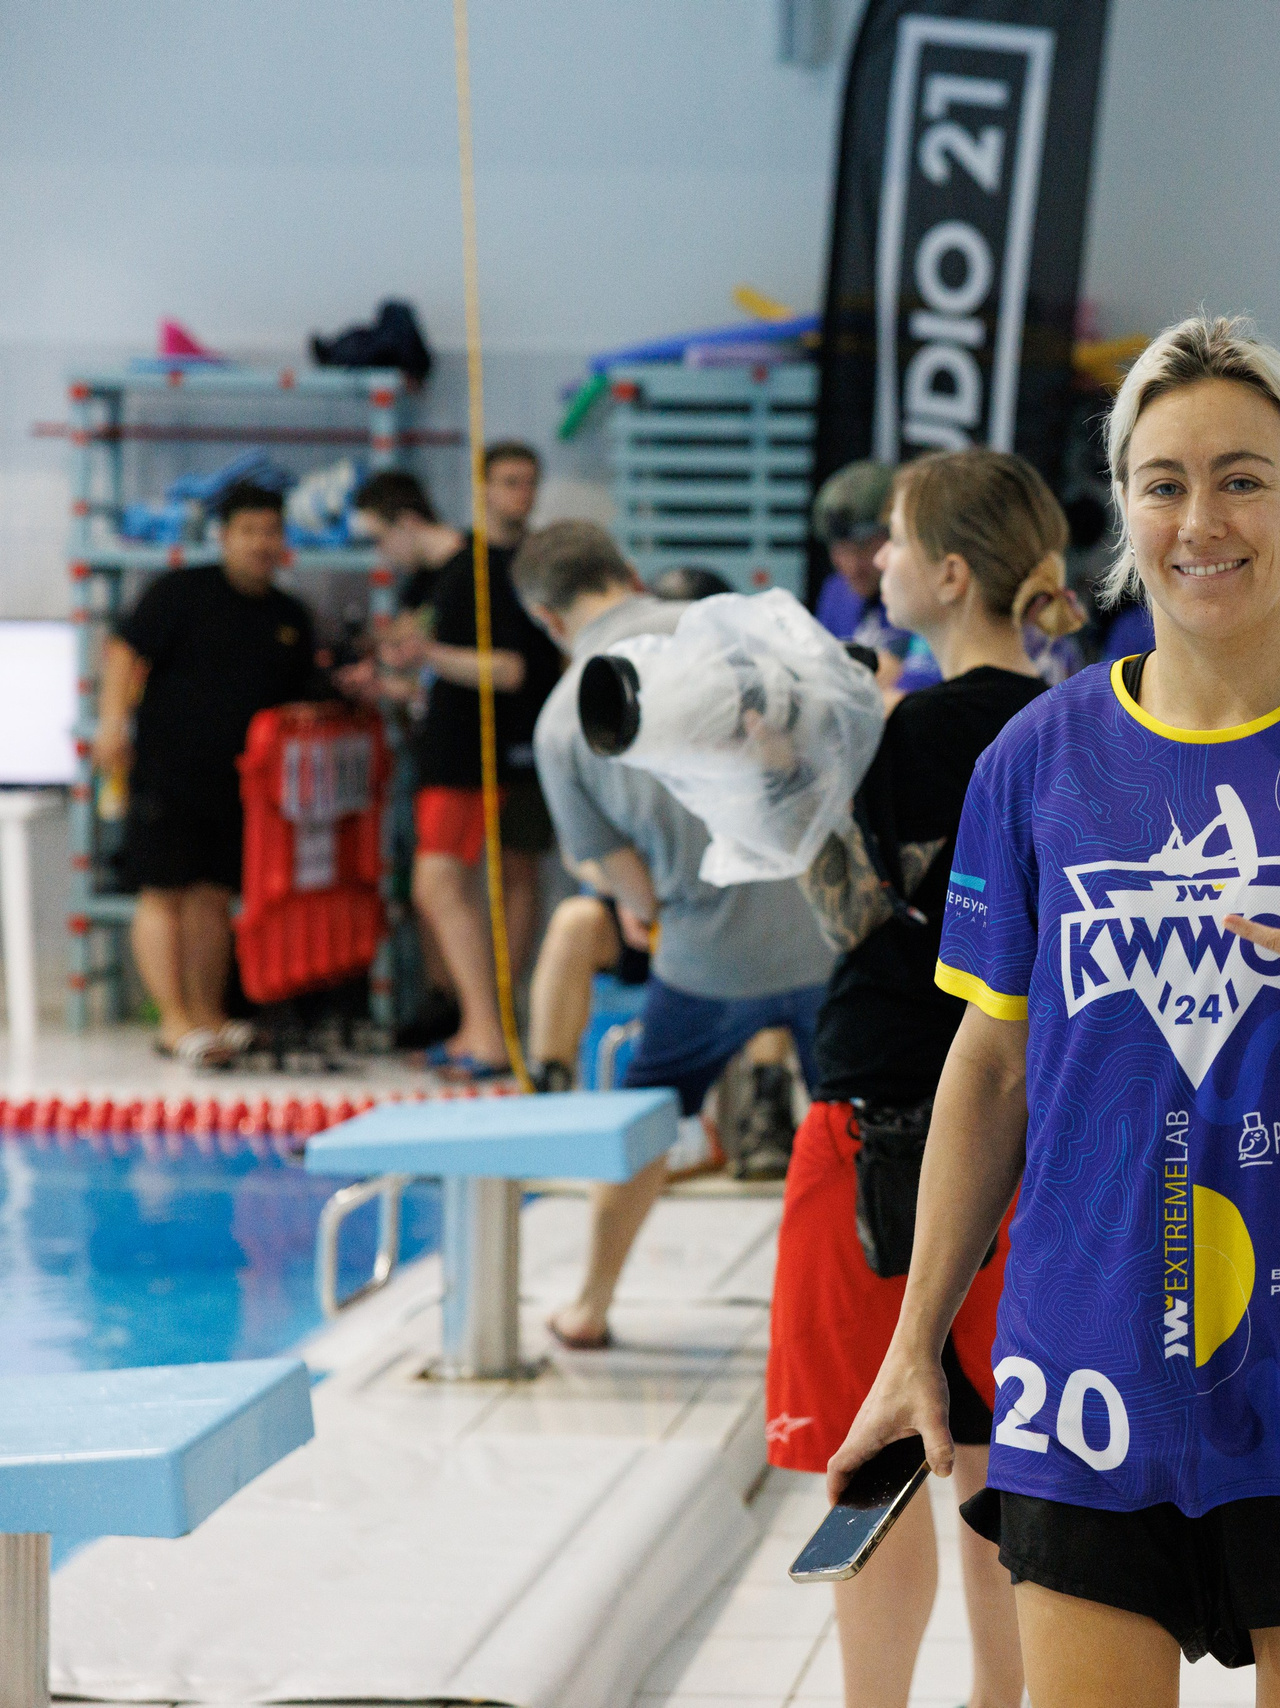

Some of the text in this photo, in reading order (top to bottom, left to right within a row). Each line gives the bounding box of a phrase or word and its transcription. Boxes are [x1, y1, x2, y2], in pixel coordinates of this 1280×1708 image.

[918, 71, 1010, 194] 21
[1173, 994, 1224, 1026] 24
[992, 1355, 1131, 1472] 20
